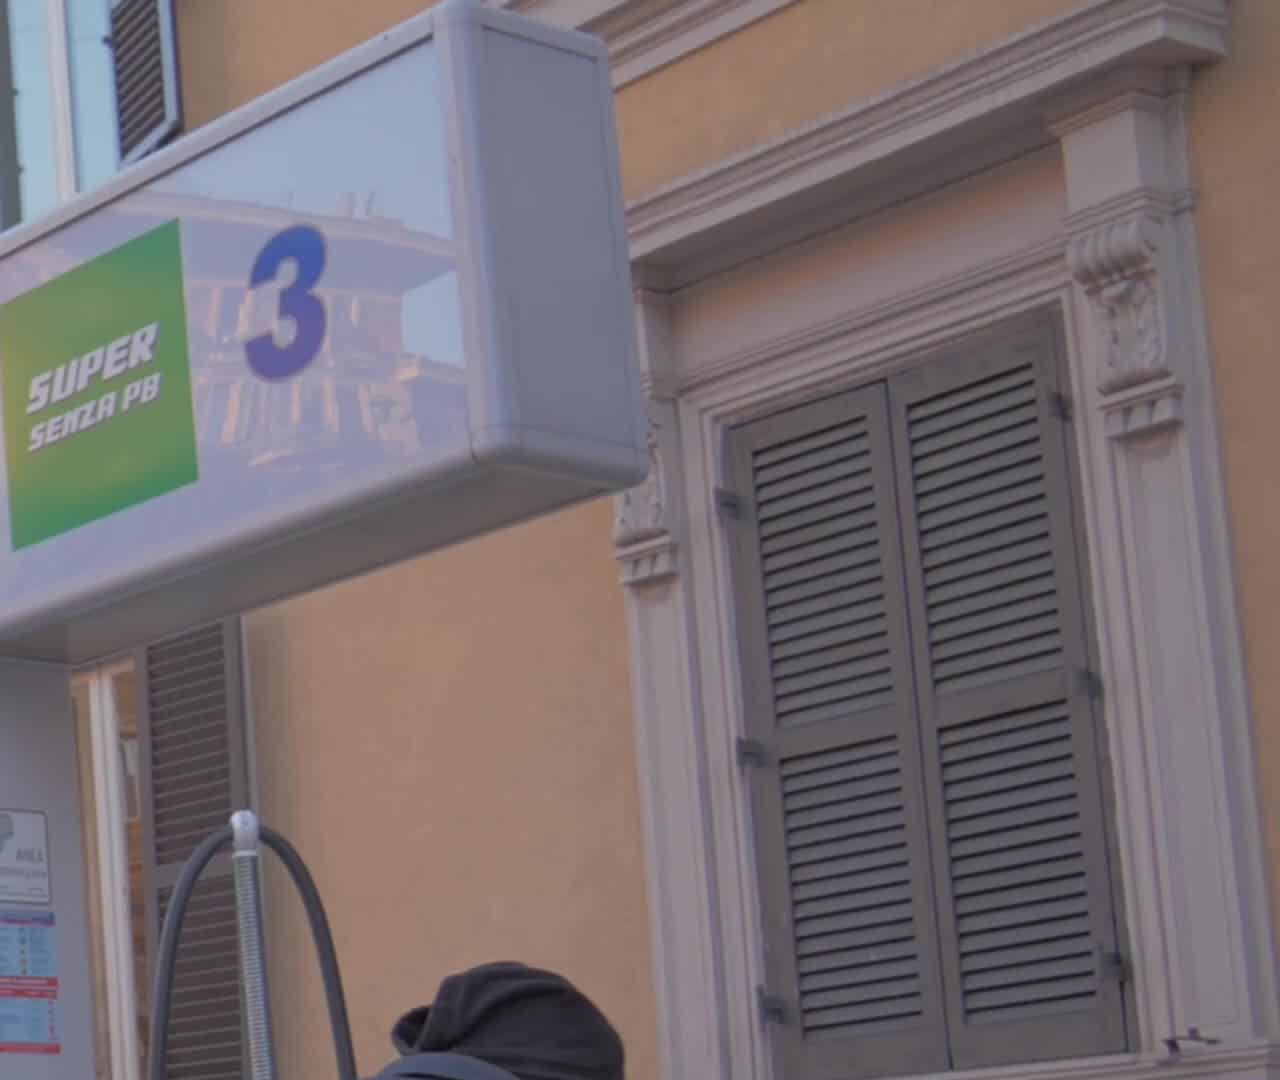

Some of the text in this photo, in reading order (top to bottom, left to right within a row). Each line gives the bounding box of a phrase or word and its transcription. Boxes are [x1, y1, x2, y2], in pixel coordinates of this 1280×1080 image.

[244, 224, 326, 381] 3
[25, 321, 160, 416] SUPER
[28, 372, 161, 452] SENZA PB
